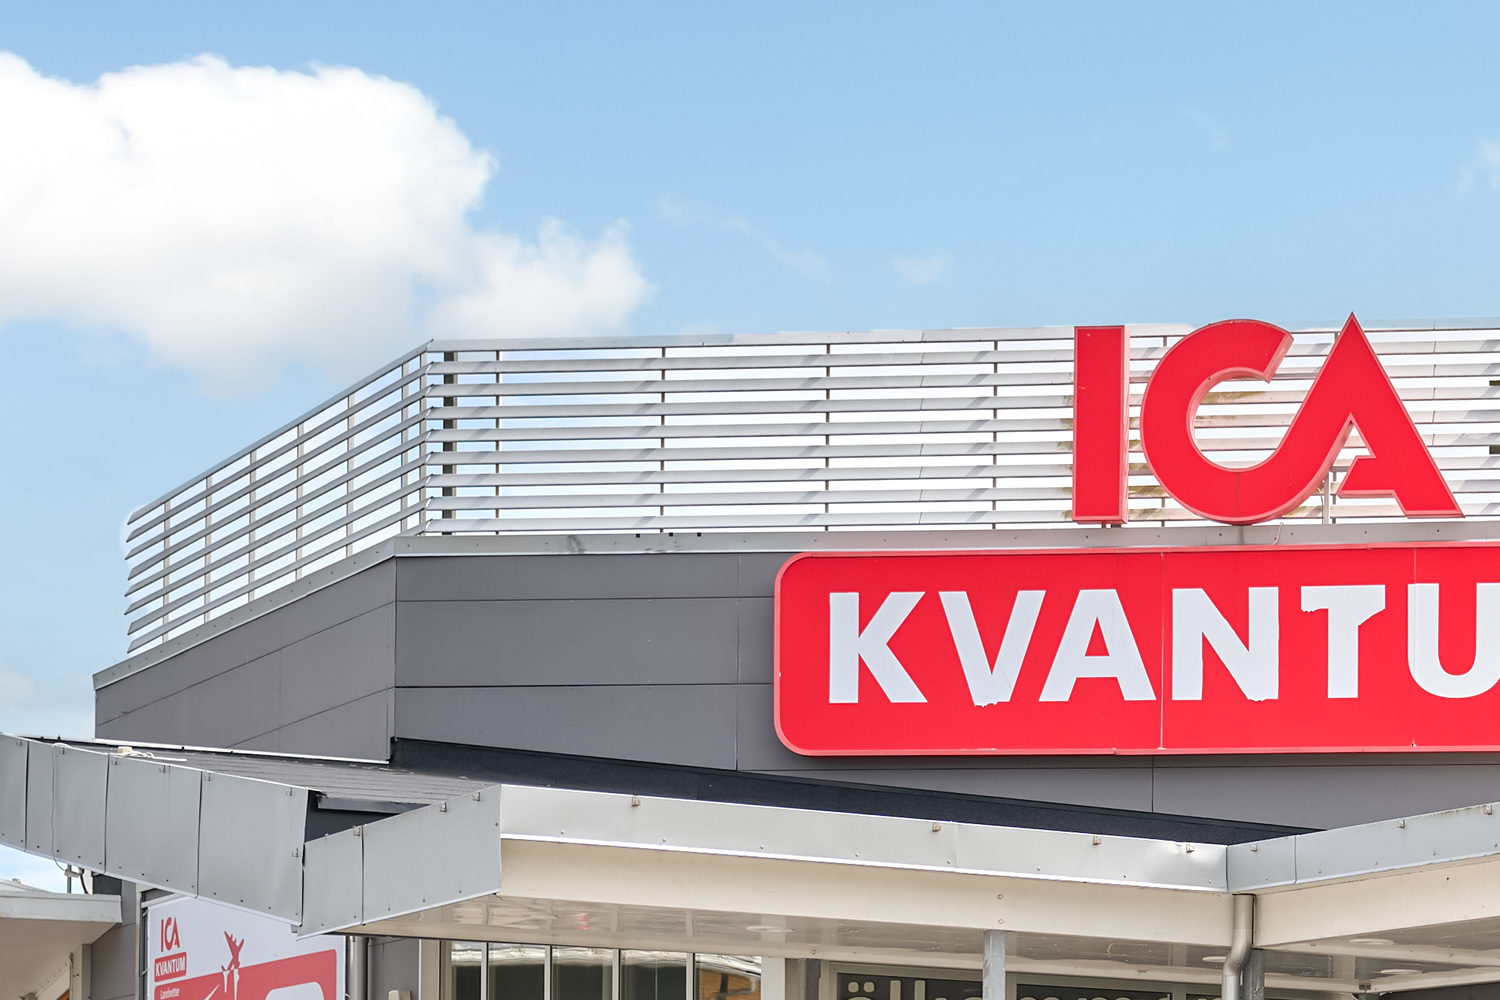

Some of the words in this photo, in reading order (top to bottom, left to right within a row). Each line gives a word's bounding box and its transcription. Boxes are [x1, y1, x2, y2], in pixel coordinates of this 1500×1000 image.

[1072, 312, 1465, 525] ICA
[160, 916, 181, 952] ICA
[155, 956, 186, 977] KVANTUM
[159, 987, 180, 1000] Landvetter
